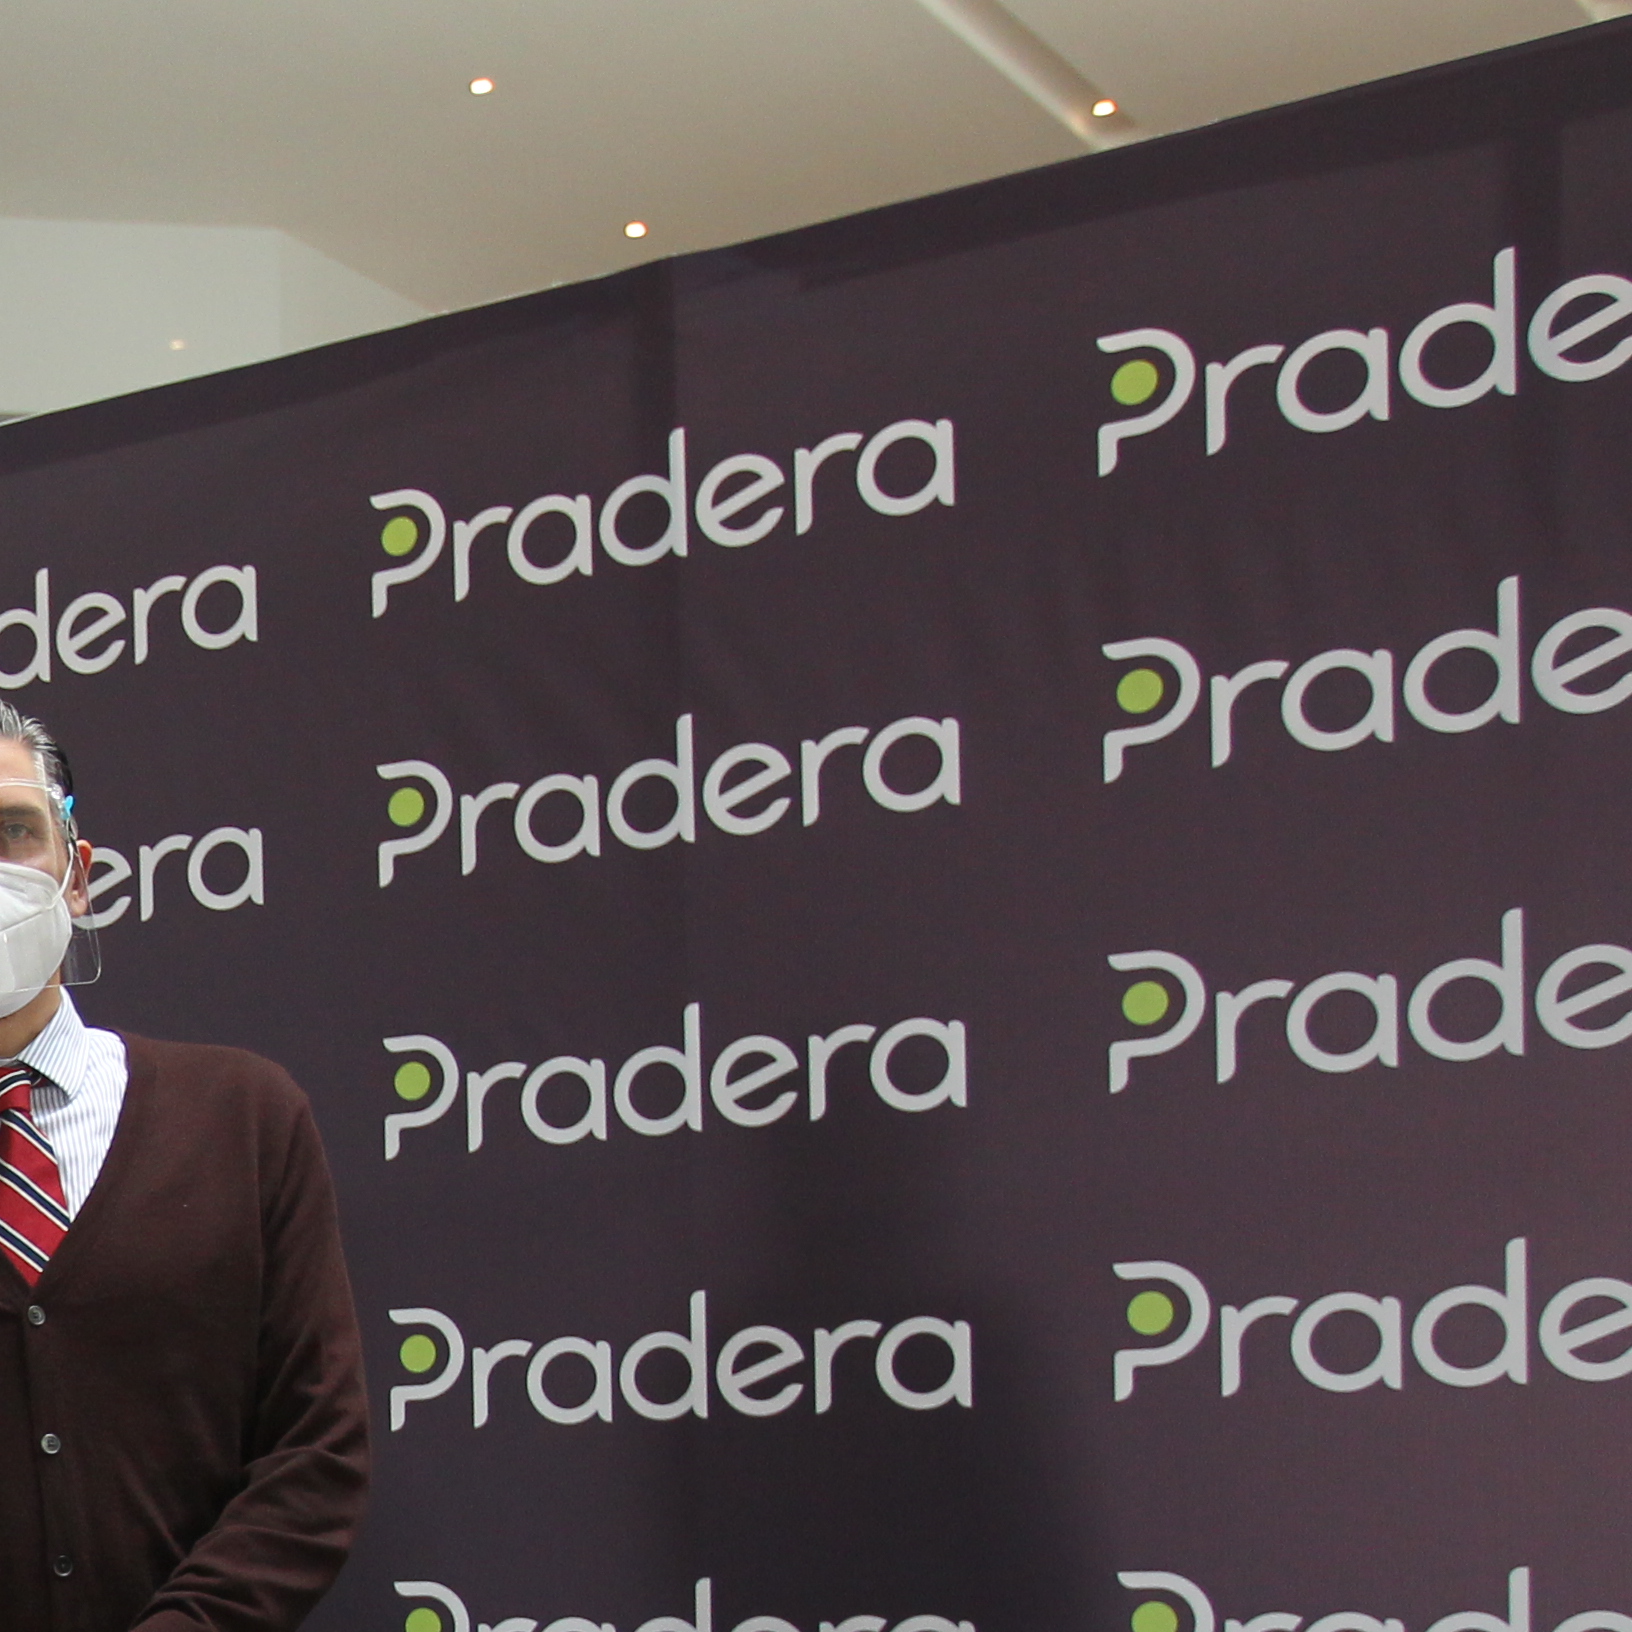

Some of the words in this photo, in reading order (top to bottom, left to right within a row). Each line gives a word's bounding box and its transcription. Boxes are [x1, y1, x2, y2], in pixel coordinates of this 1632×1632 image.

[1097, 247, 1632, 476] Prade
[370, 419, 954, 617] Pradera
[1102, 576, 1632, 783] Prade
[377, 714, 960, 887] Pradera
[383, 1003, 966, 1160] Pradera
[1108, 908, 1632, 1093] Prade
[389, 1290, 971, 1431] Pradera
[1113, 1238, 1632, 1401] Prade
